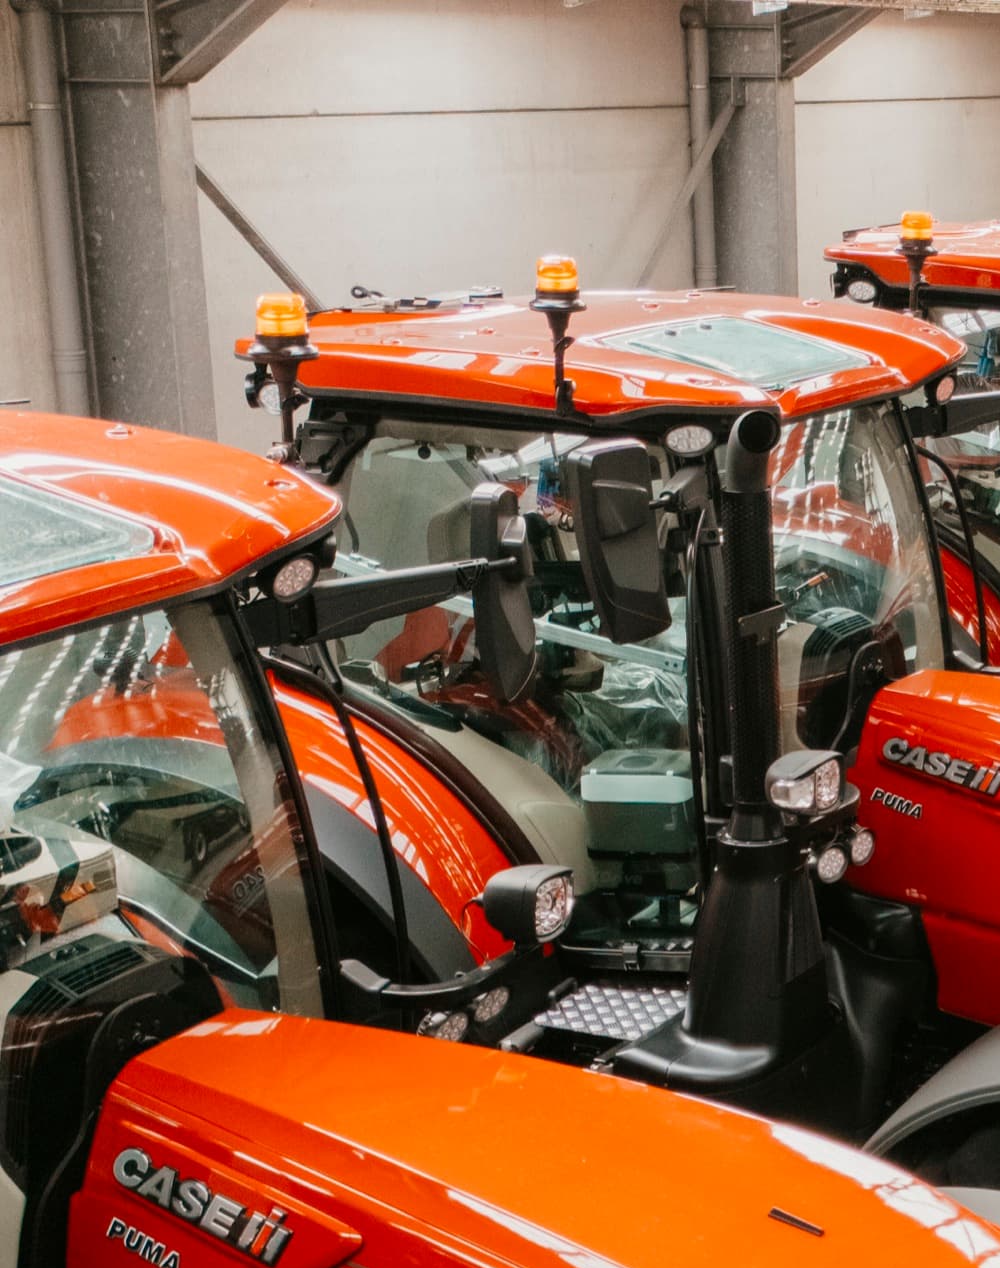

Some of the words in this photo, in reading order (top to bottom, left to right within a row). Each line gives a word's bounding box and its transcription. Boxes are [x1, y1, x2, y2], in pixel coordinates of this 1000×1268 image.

[882, 737, 974, 785] CASE
[869, 787, 923, 820] PUMA
[112, 1147, 245, 1241] CASE
